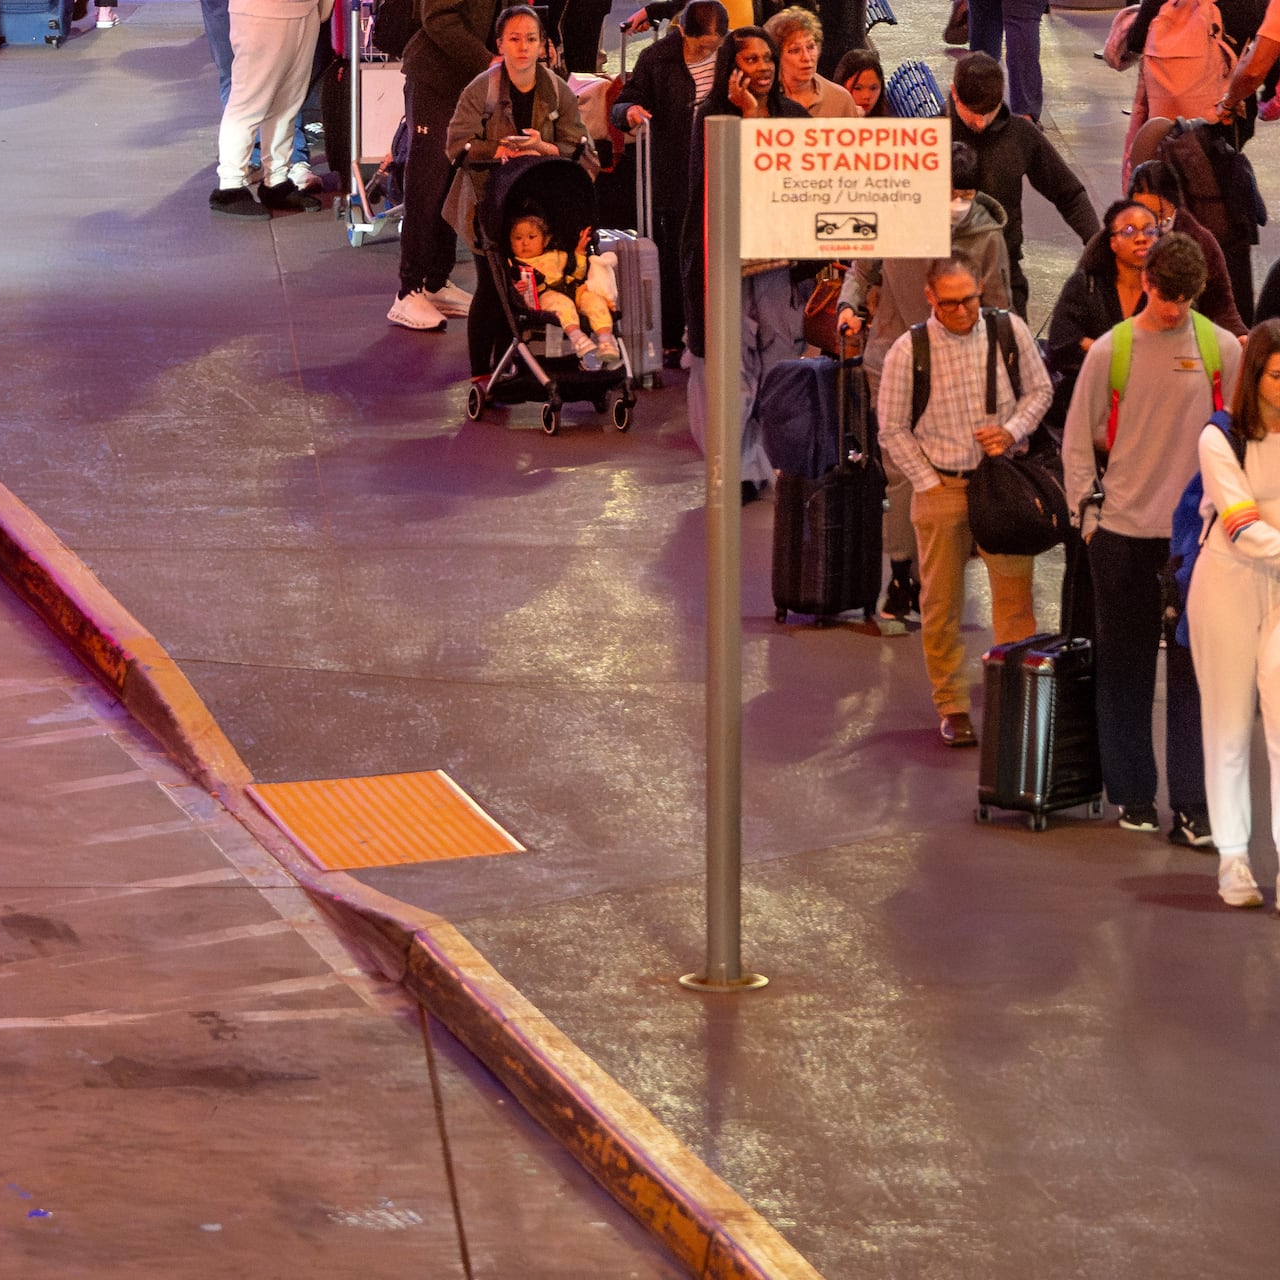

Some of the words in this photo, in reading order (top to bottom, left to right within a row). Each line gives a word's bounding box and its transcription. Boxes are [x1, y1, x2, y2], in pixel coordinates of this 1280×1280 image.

[756, 128, 795, 147] NO
[804, 128, 938, 147] STOPPING
[754, 153, 792, 171] OR
[801, 152, 939, 171] STANDING
[783, 177, 833, 190] Except
[838, 176, 858, 189] for
[864, 177, 911, 189] Active
[771, 191, 831, 204] Loading
[835, 191, 842, 204] /
[847, 191, 922, 204] Unloading
